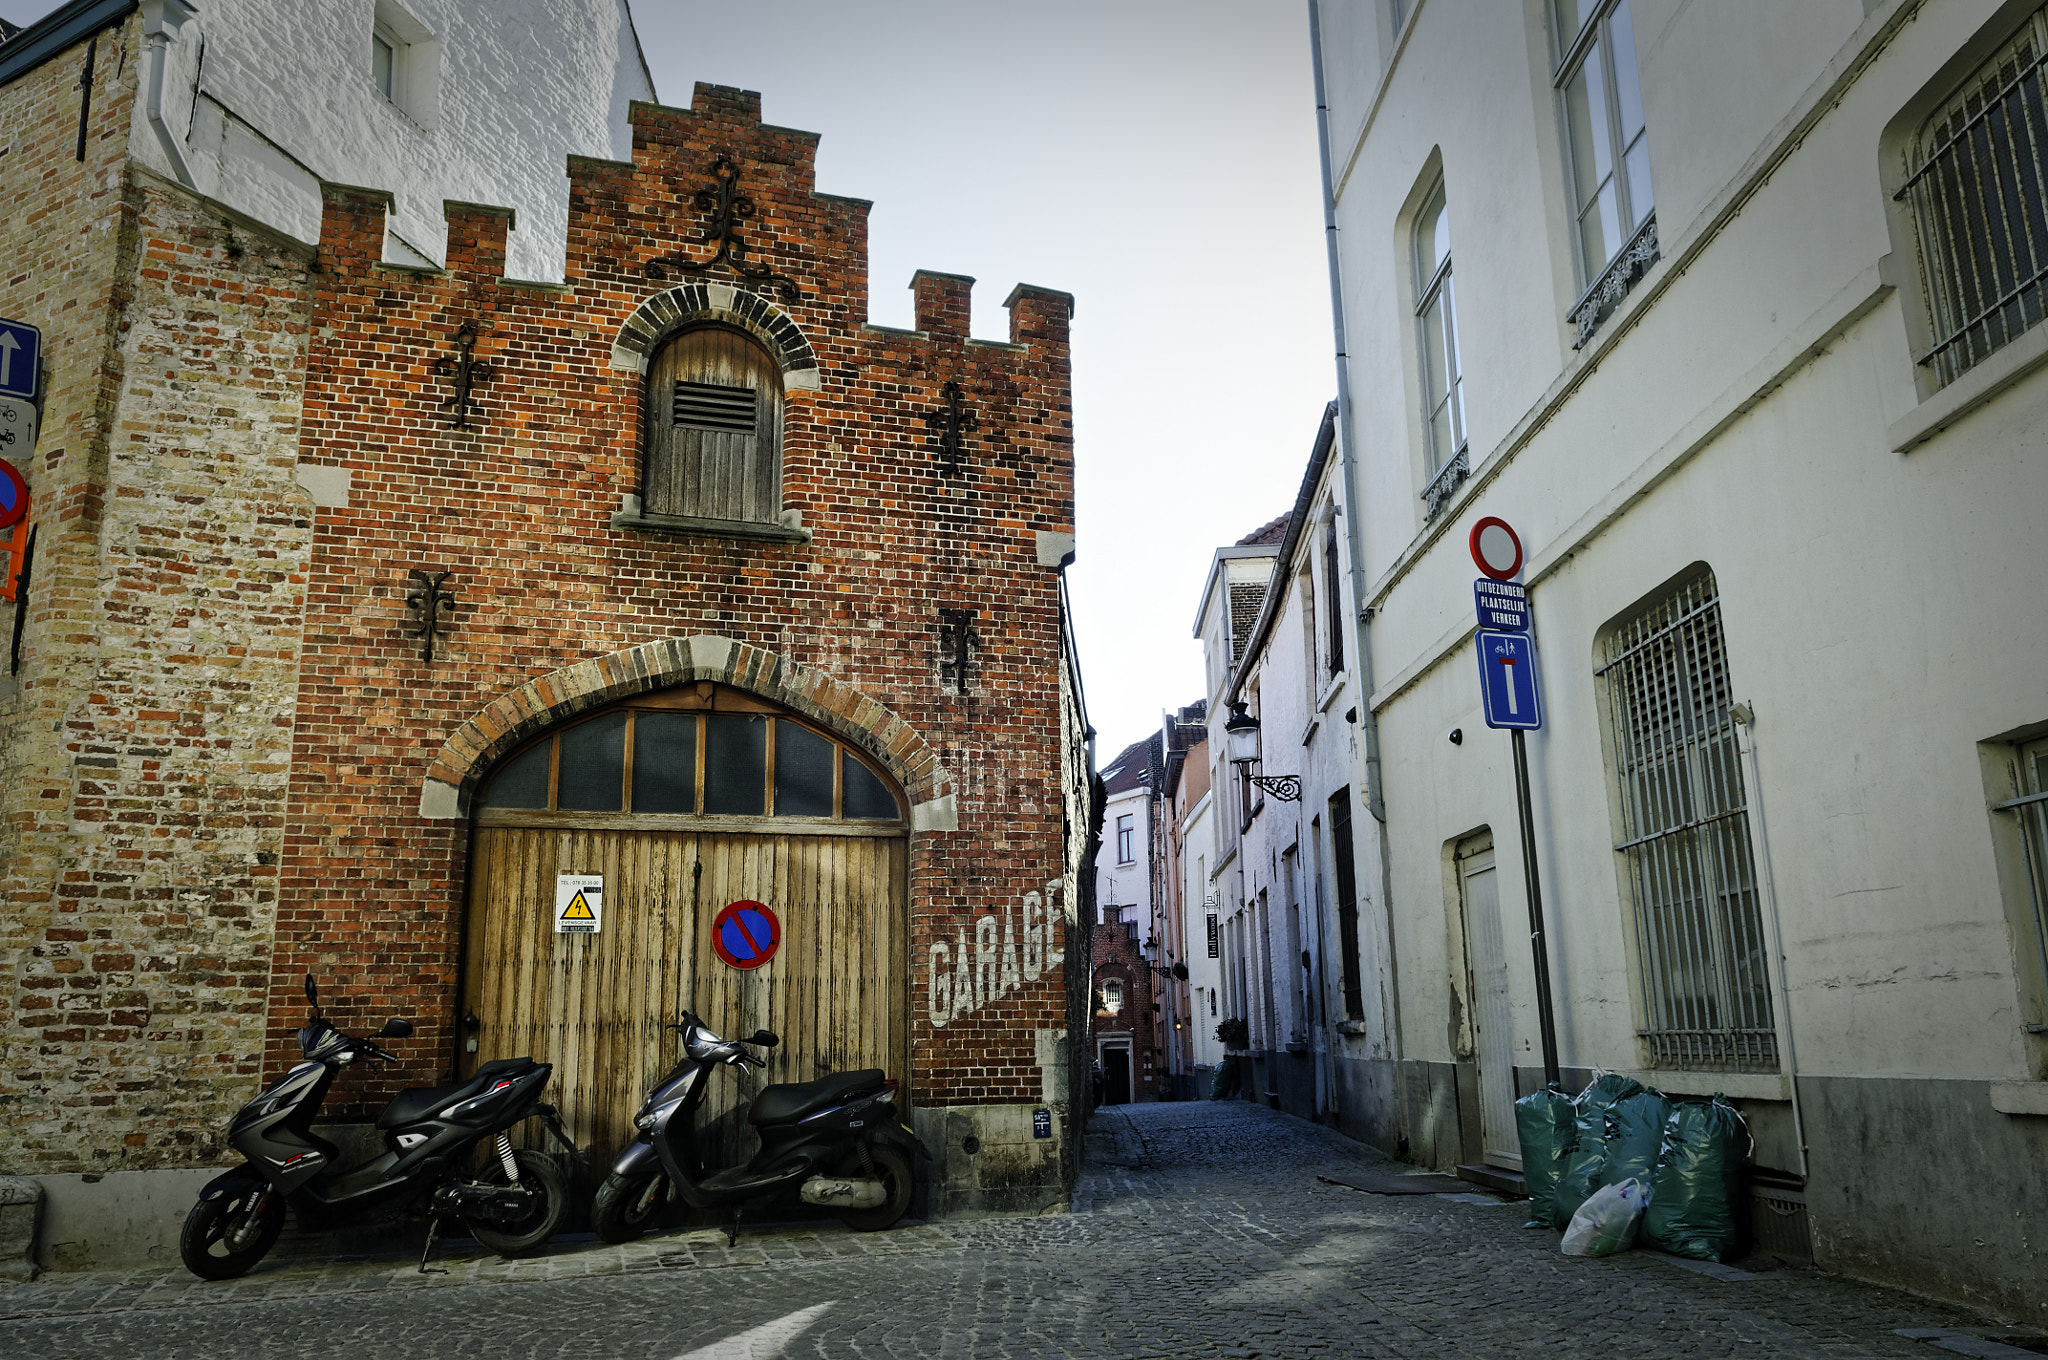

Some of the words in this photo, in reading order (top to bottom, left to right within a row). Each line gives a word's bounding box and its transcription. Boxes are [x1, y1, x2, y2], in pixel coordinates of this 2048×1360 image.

[1476, 580, 1525, 598] UITGEZONDERD
[1480, 595, 1525, 612] PLAATSELIJK
[1491, 611, 1521, 627] VERKEER
[1207, 915, 1219, 957] Hollywood
[928, 878, 1065, 1028] GARAGE
[244, 1191, 260, 1212] YAMAHA
